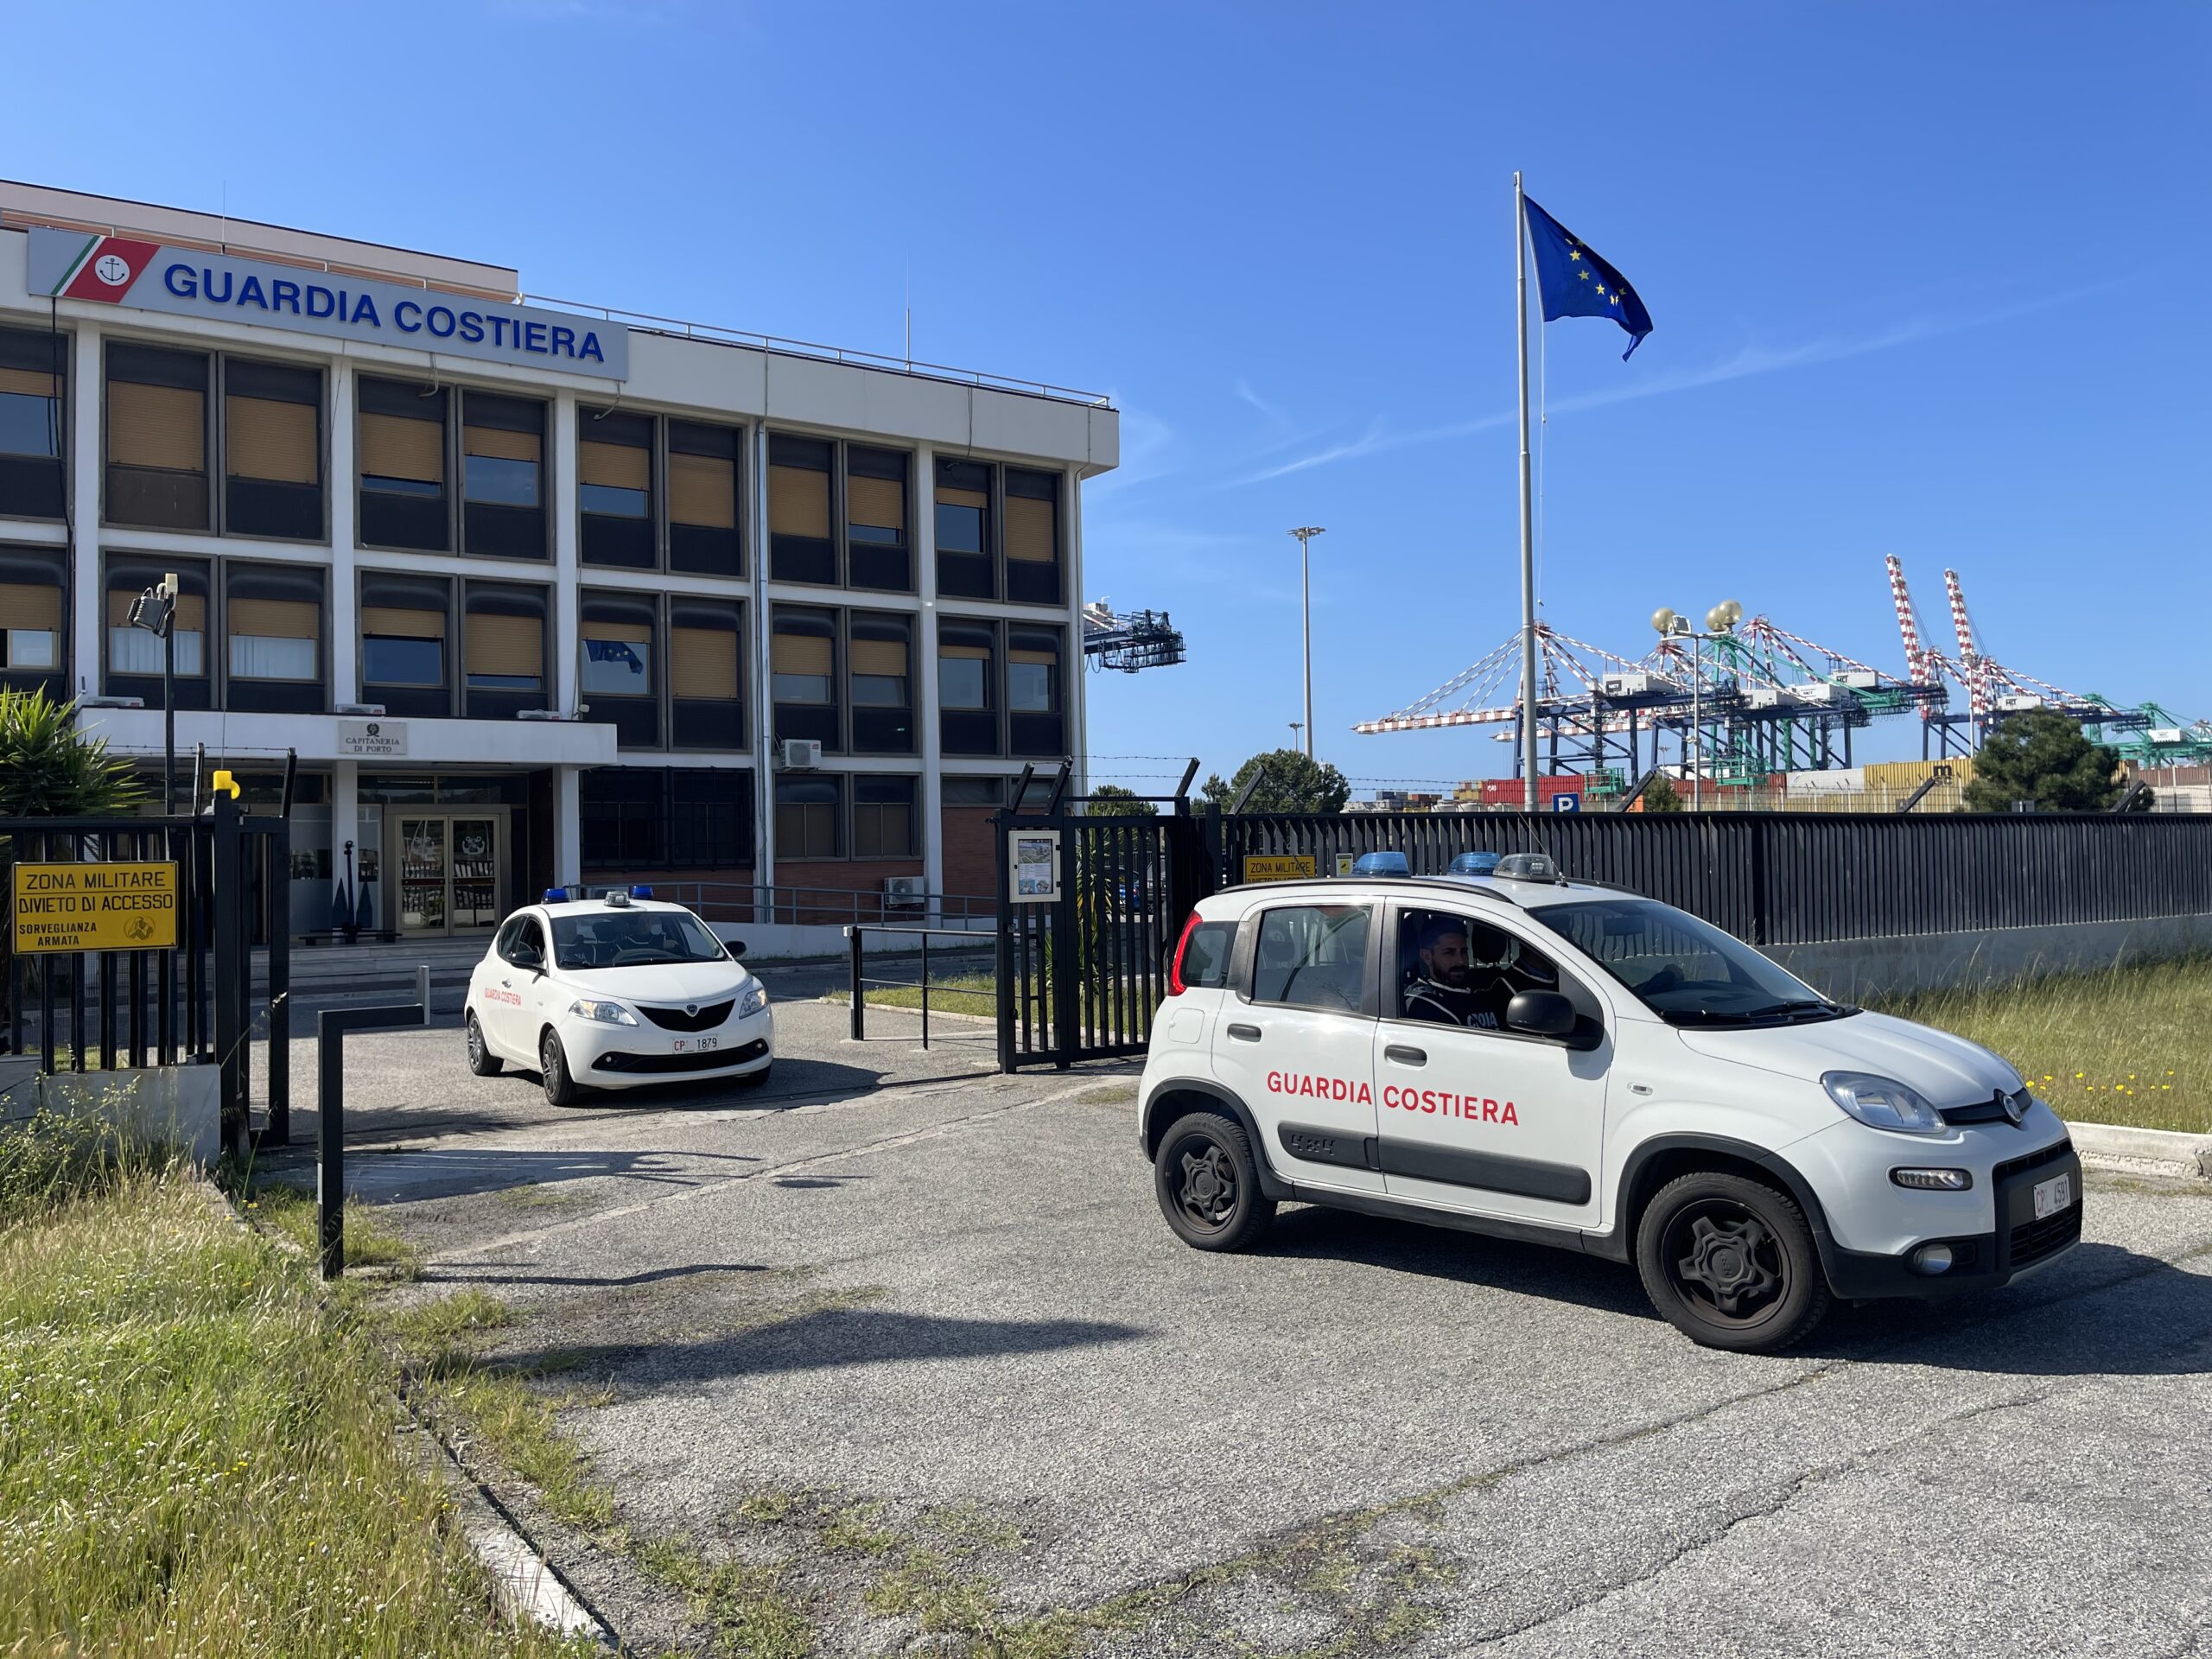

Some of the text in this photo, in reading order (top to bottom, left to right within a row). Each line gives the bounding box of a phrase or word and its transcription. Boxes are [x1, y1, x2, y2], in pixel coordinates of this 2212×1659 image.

[163, 264, 606, 363] GUARDIA COSTIERA
[346, 737, 400, 746] CAPITANERIA
[1558, 797, 1573, 812] P
[1250, 861, 1311, 873] ZONA MILITARE
[26, 872, 166, 889] ZONA MILITARE
[19, 894, 173, 913] DIVIETO DI ACCESSO
[19, 922, 97, 934] SORVEGLIANZA
[37, 936, 79, 946] ARMATA
[485, 988, 522, 1006] GUARDIA COSTIERA
[674, 1038, 717, 1051] CP 1879
[1267, 1071, 1519, 1126] GUARDIA COSTIERA
[2036, 1189, 2045, 1212] CP
[2054, 1179, 2069, 1204] 4591
